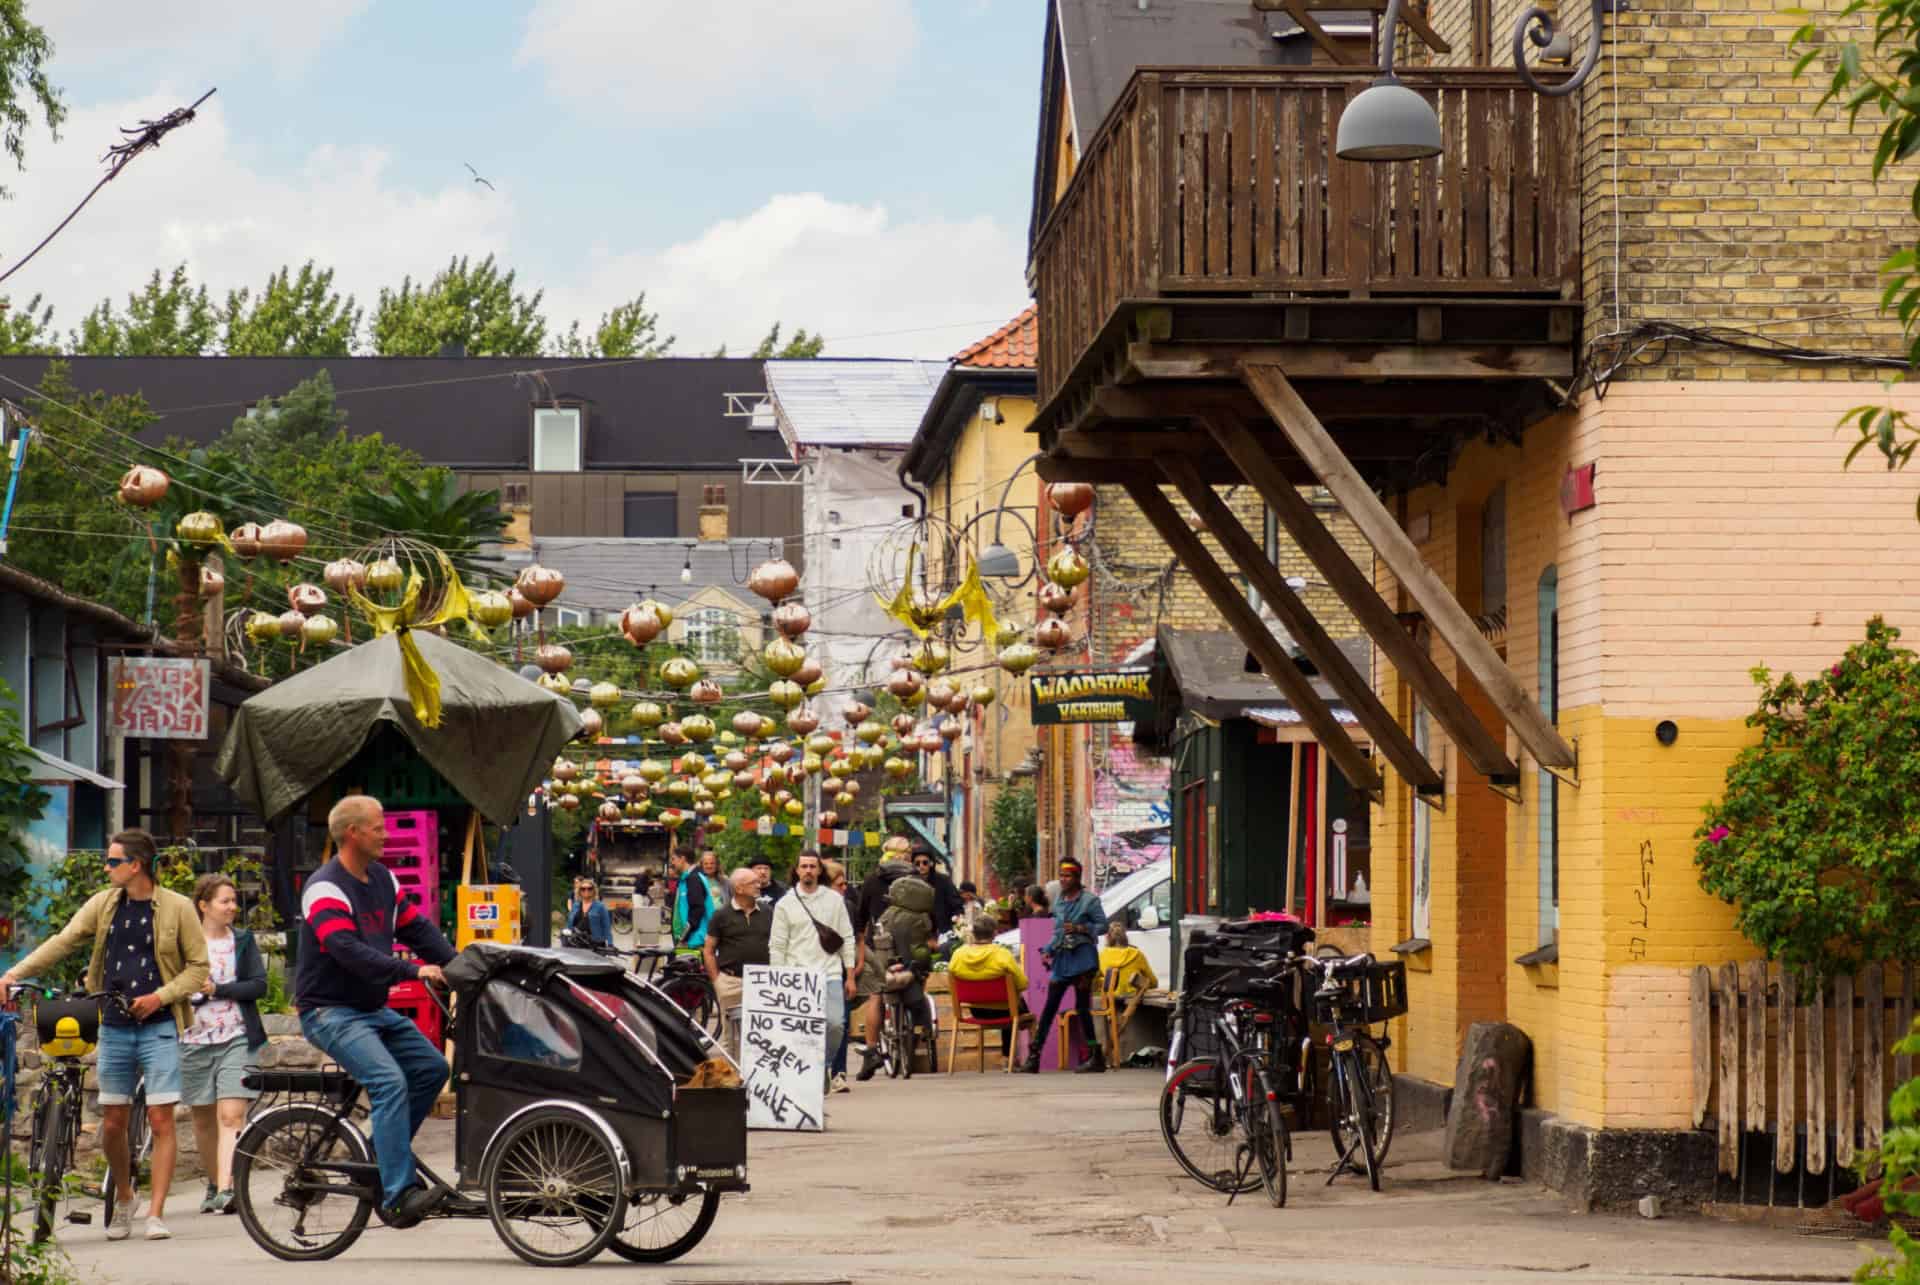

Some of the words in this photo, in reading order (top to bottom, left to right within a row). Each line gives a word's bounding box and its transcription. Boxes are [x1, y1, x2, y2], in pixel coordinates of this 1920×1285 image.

[749, 971, 817, 995] INGEN
[750, 1014, 773, 1031] NO
[780, 1017, 824, 1035] SALE
[755, 1054, 781, 1078] ER
